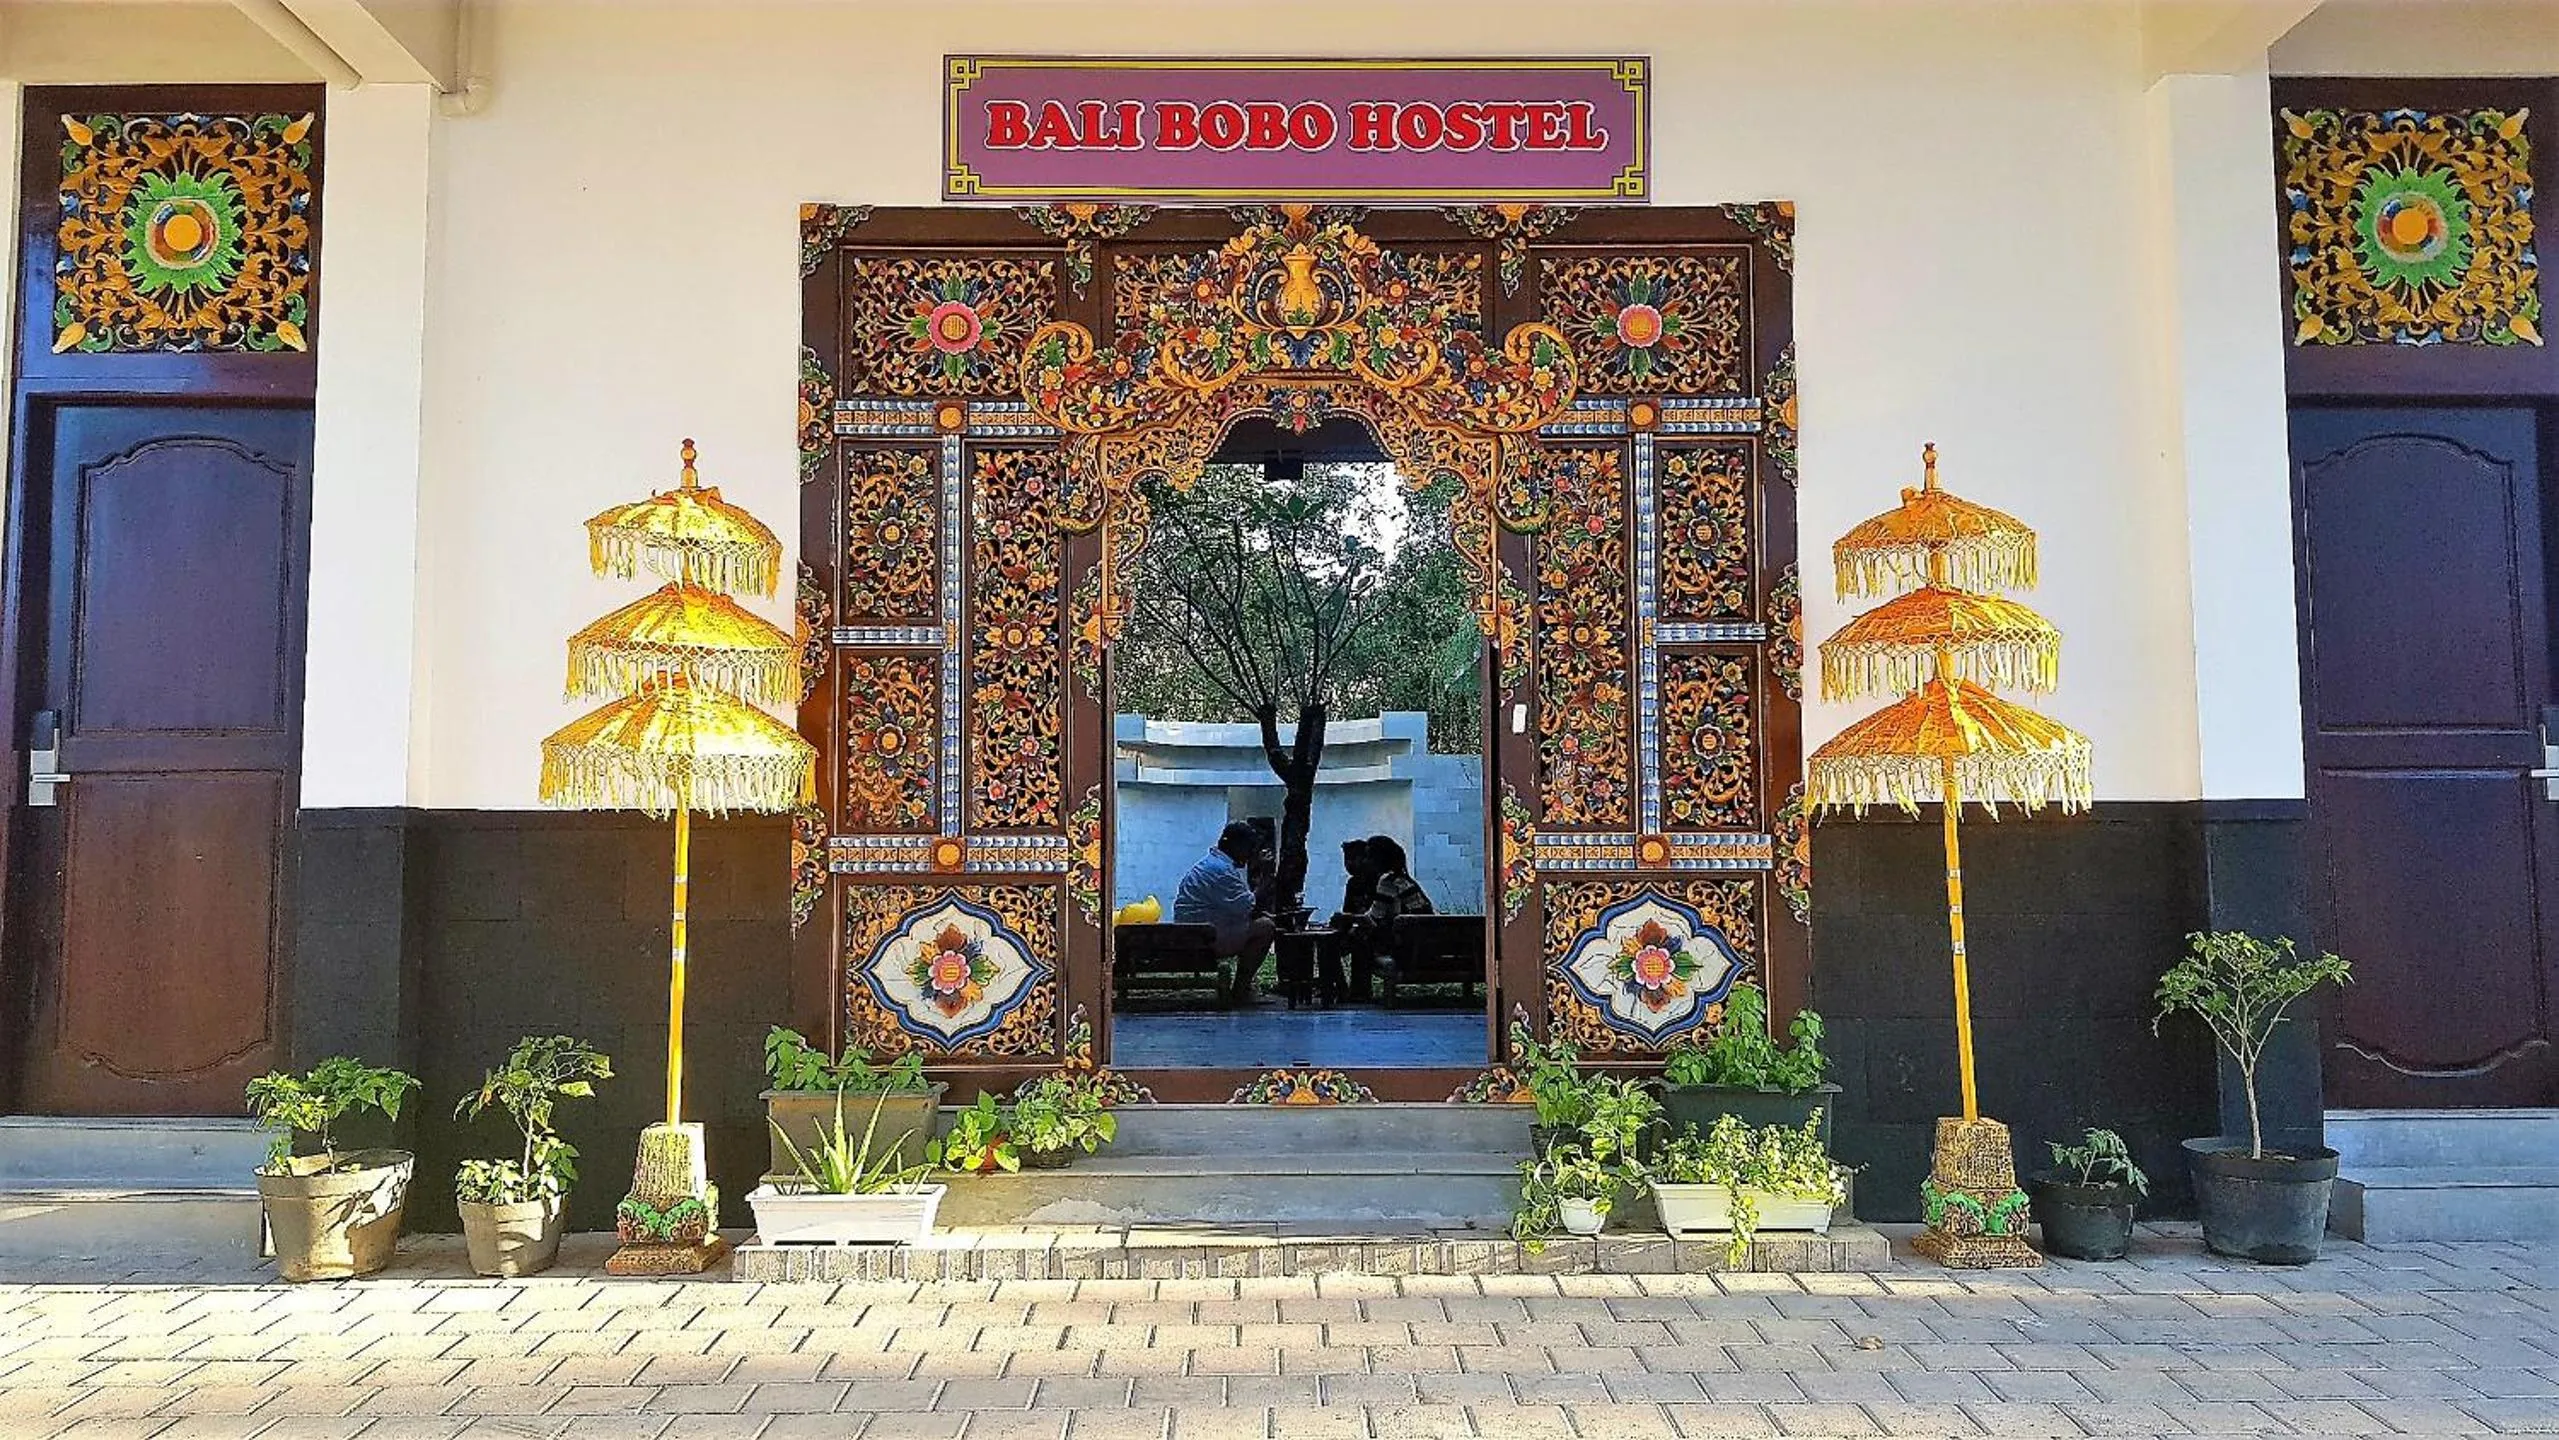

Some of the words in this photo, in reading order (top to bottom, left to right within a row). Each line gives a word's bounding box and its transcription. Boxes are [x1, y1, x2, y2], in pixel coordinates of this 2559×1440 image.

[986, 102, 1143, 149] BALI
[1155, 102, 1335, 150] BOBO
[1348, 102, 1607, 150] HOSTEL
